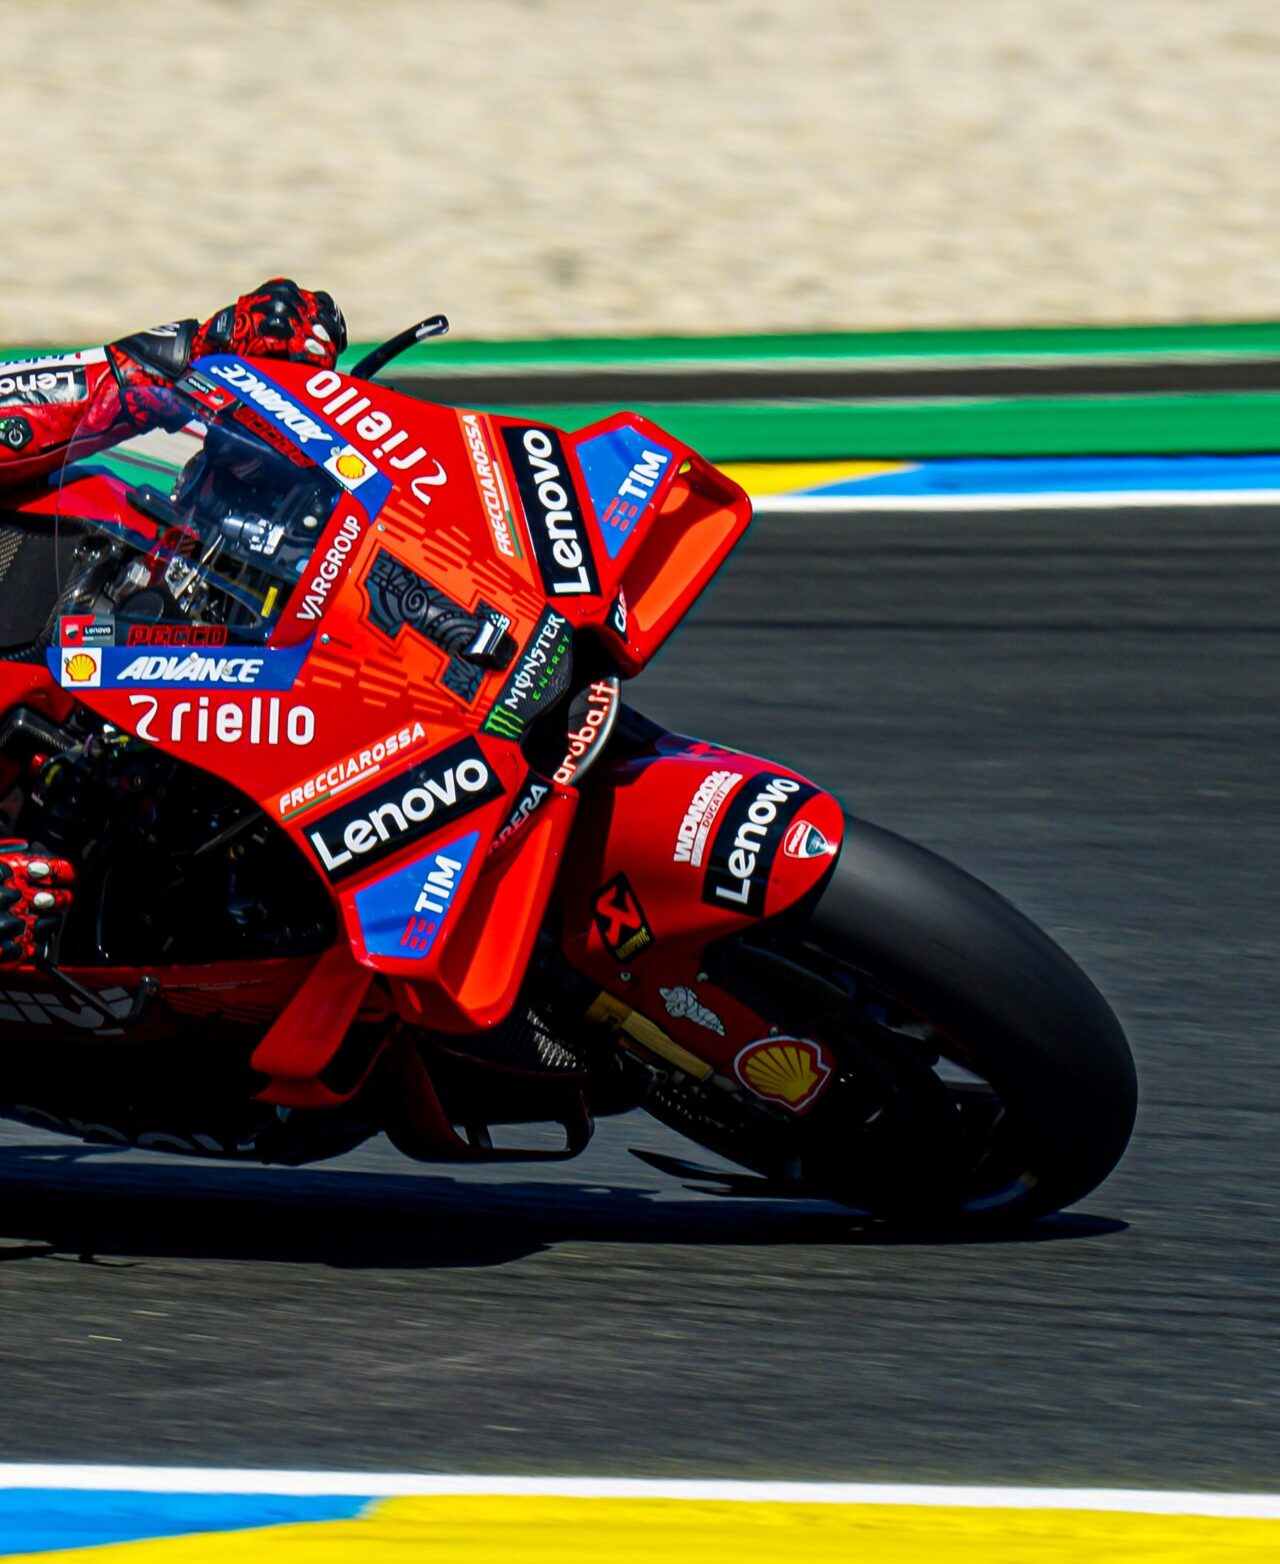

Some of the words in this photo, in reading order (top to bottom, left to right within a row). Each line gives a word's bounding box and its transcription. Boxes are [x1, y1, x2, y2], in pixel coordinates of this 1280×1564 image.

[218, 363, 333, 441] ADVANCE
[305, 370, 416, 471] riello
[461, 414, 514, 557] FRECCIAROSSA
[523, 428, 592, 597] Lenovo
[618, 449, 668, 501] TIM
[297, 515, 361, 622] VARGROUP
[117, 656, 264, 683] ADVANCE
[126, 624, 228, 648] PECCO
[505, 613, 566, 709] MONSTER
[532, 634, 570, 700] ENERGY
[171, 697, 315, 746] riello
[553, 681, 618, 785] aruba.it
[278, 722, 426, 814] FRECCIAROSSA
[702, 789, 726, 828] DUCATI
[310, 758, 489, 871] Lenovo
[715, 778, 800, 904] Lenovo
[415, 854, 462, 914] TIM
